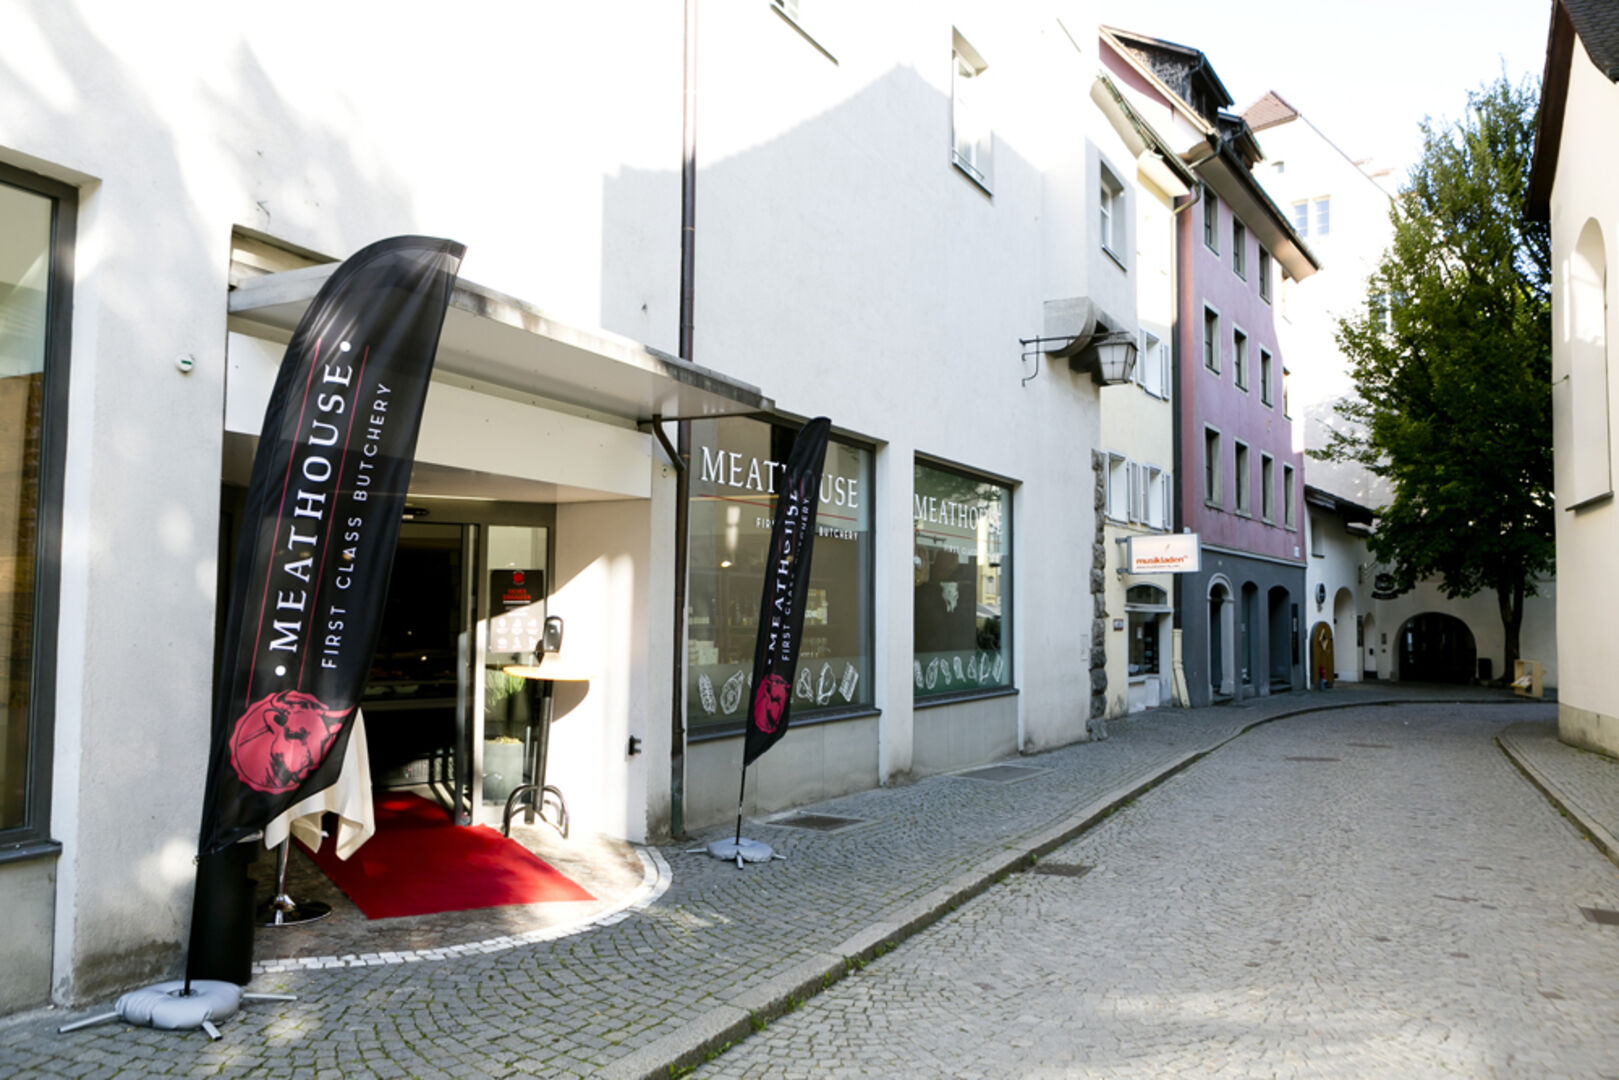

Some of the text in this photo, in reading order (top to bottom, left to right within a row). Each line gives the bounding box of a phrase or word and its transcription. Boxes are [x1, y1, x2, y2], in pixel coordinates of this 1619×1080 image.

[269, 363, 353, 653] MEATHOUSE
[701, 446, 858, 508] MEATUSE
[321, 383, 392, 669] FIRST CLASS BUTCHERY
[819, 526, 858, 541] BUTCHERY
[781, 624, 791, 662] FIRST
